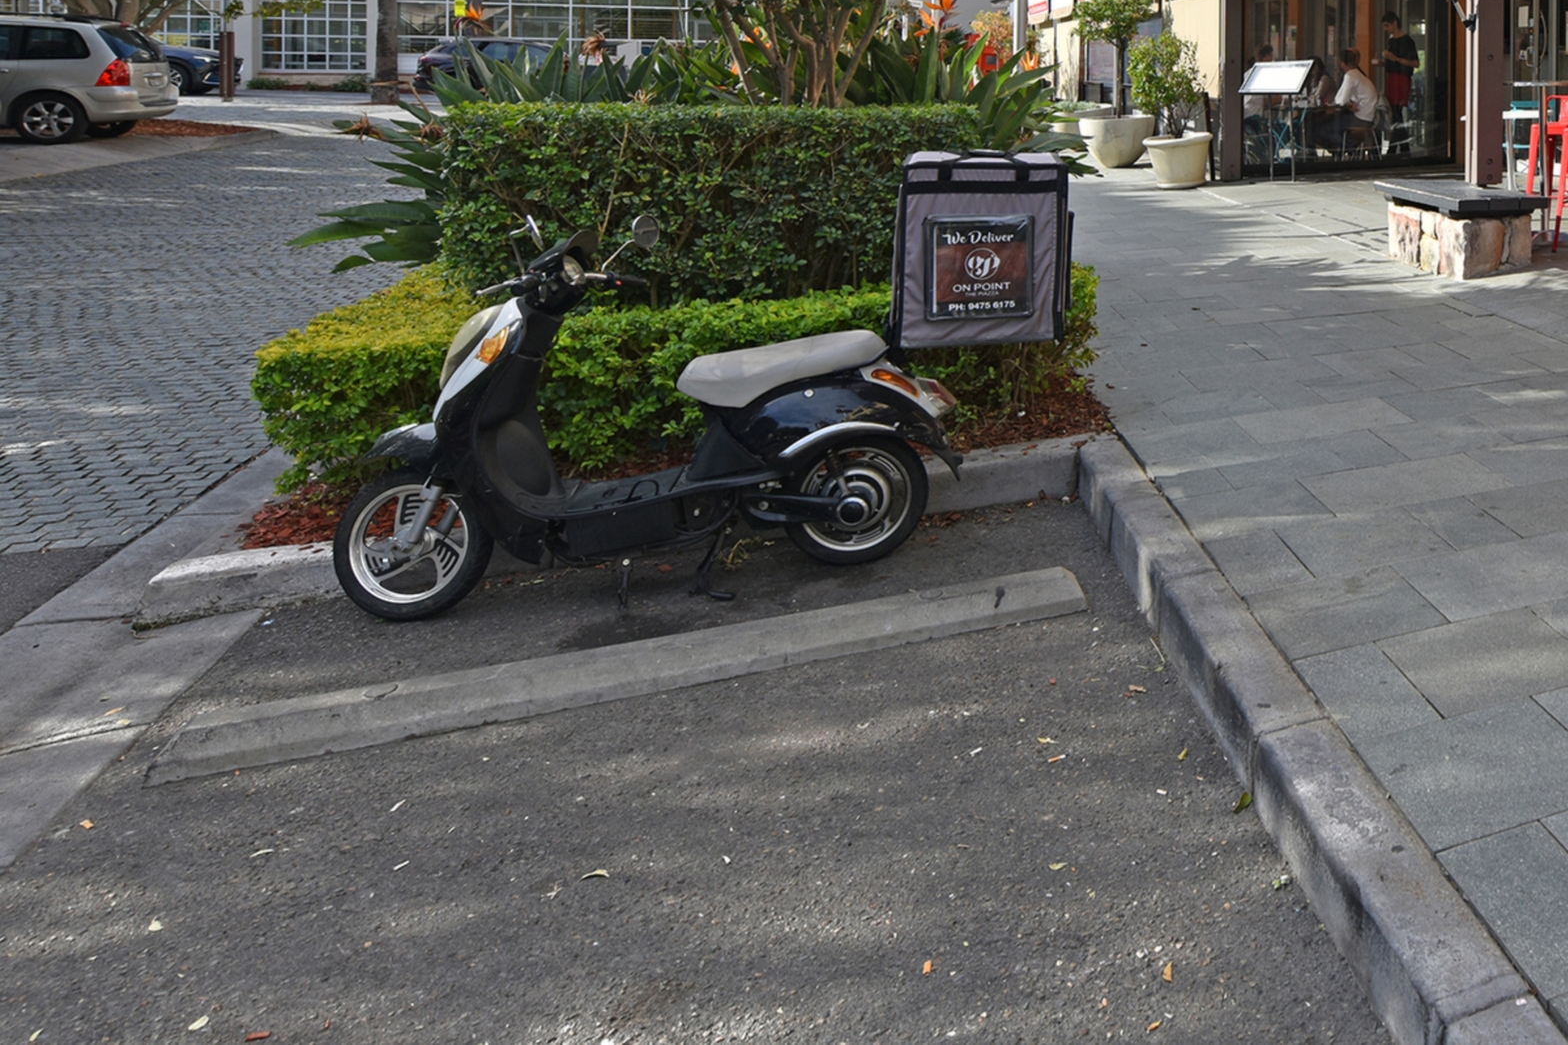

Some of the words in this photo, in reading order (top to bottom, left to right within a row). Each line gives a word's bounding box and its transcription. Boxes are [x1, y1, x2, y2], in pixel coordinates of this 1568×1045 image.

[942, 232, 967, 245] We
[967, 230, 1014, 244] Deliver
[952, 284, 971, 293] ON
[973, 281, 1011, 291] POINT
[948, 303, 966, 312] PH:
[967, 301, 991, 311] 9475
[992, 300, 1016, 309] 6175
